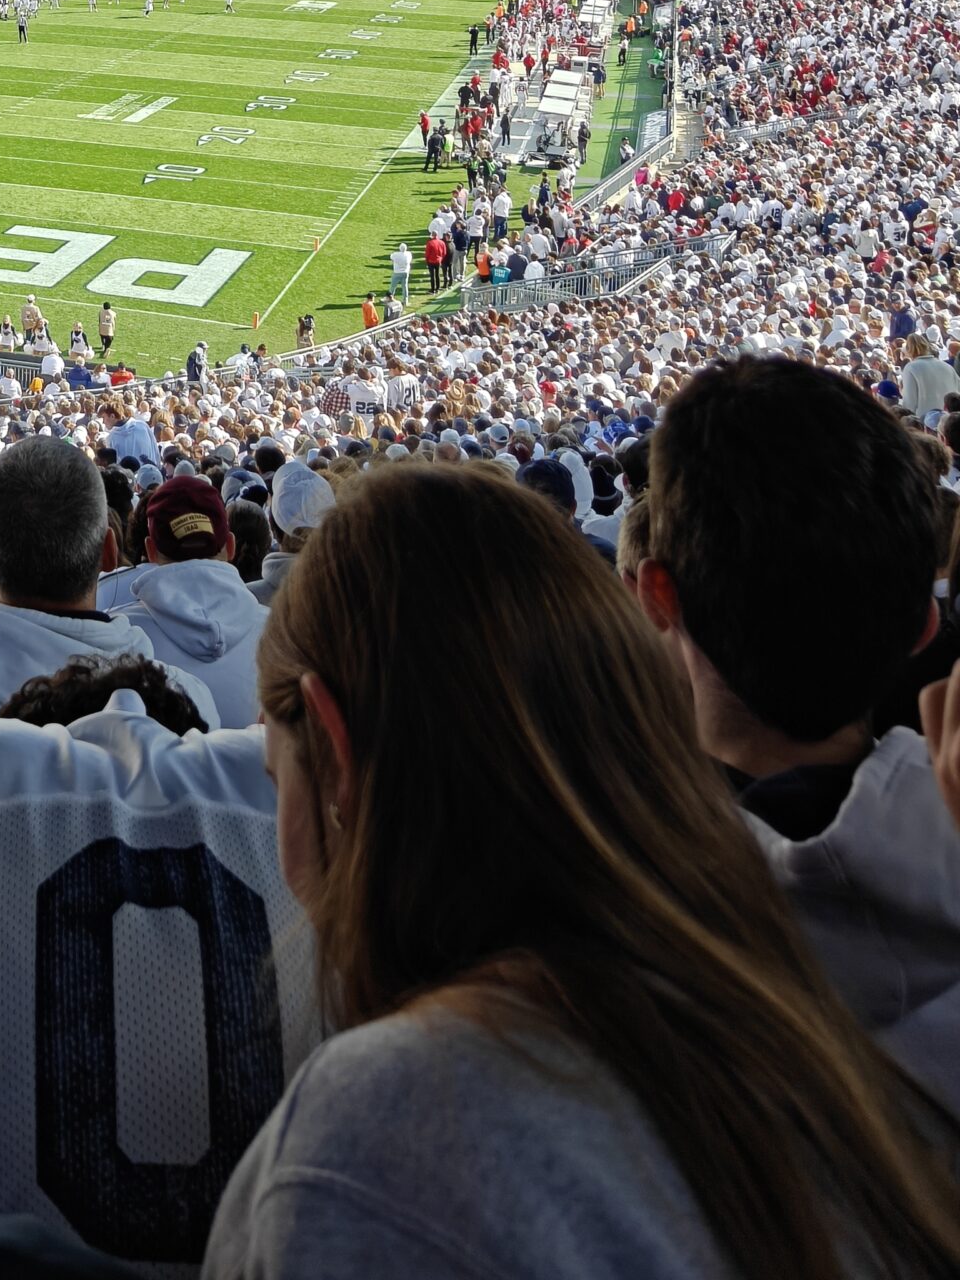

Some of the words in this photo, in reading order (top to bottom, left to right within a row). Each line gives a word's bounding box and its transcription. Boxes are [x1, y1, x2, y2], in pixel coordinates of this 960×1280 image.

[246, 96, 296, 110] 30
[199, 126, 256, 146] 20
[144, 164, 206, 183] 10
[771, 208, 781, 218] 12
[404, 384, 416, 406] 21
[356, 401, 377, 414] 22
[184, 523, 198, 532] IRAQ
[36, 837, 284, 1263] 0
